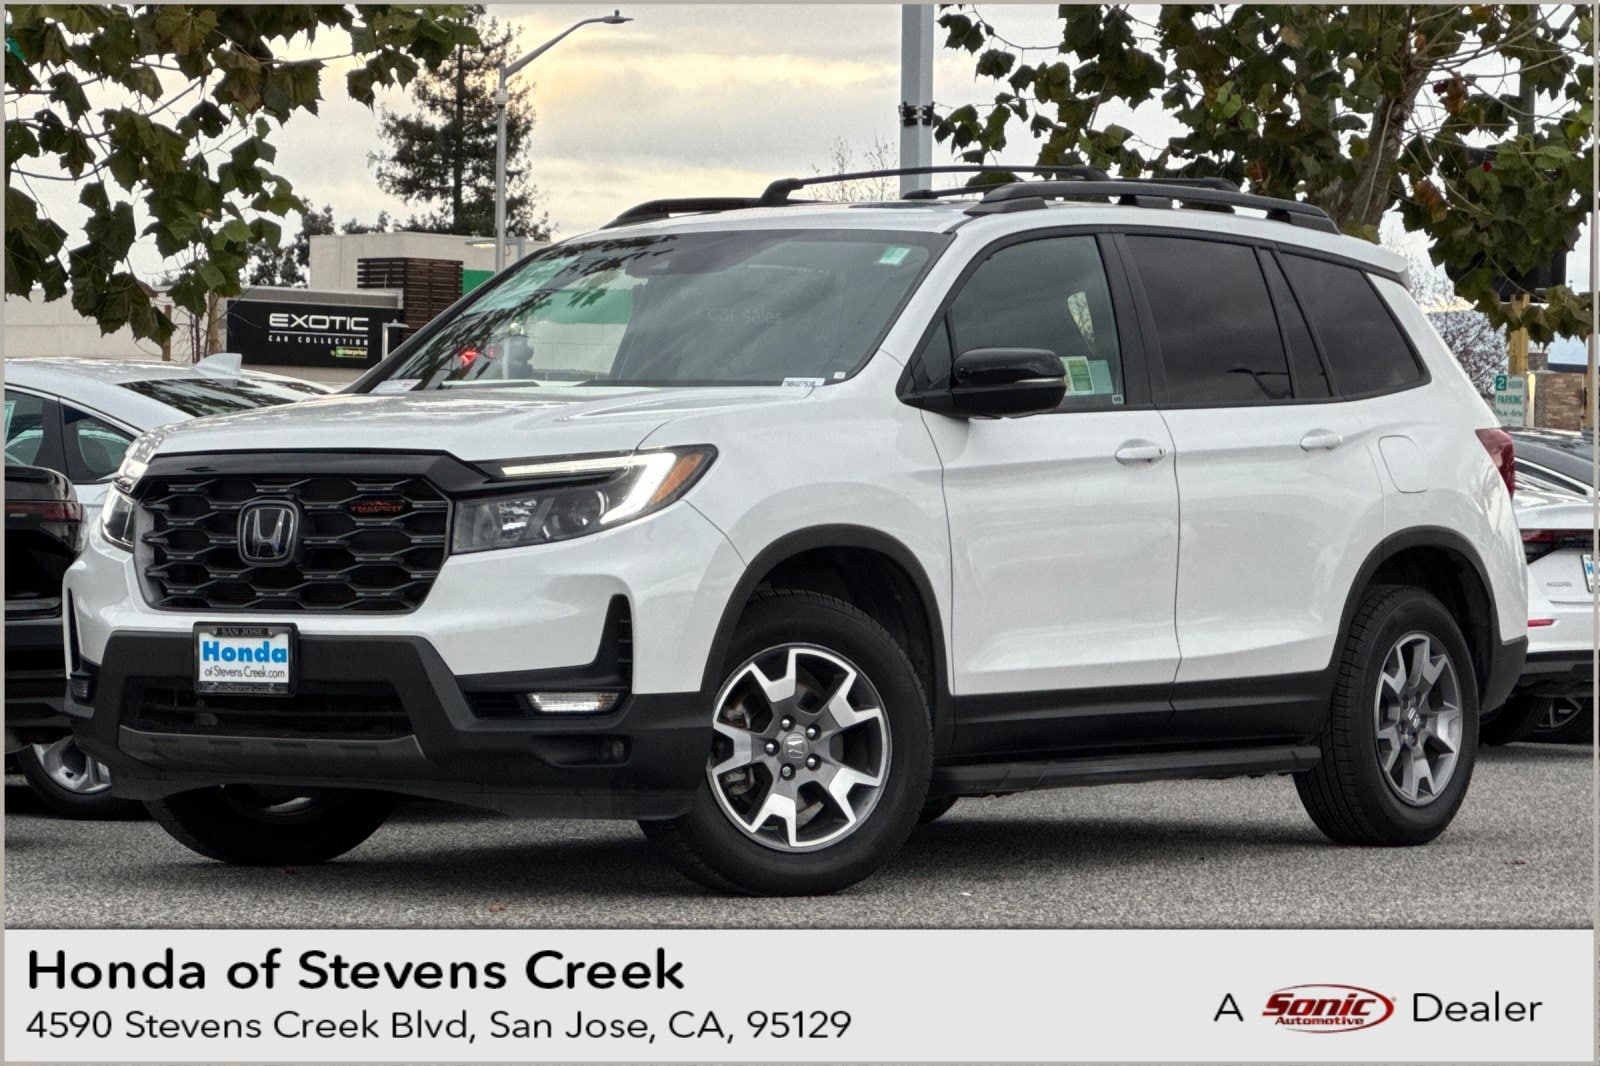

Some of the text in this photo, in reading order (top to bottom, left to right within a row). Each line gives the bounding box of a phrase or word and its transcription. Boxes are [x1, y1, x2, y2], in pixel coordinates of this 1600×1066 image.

[269, 313, 369, 331] EXOTIC
[268, 335, 369, 346] CAR COLLECTION
[1497, 377, 1524, 390] 2 HOUR
[1497, 395, 1523, 405] PARKING
[221, 627, 265, 637] SAN JOSE
[203, 640, 287, 663] Honda
